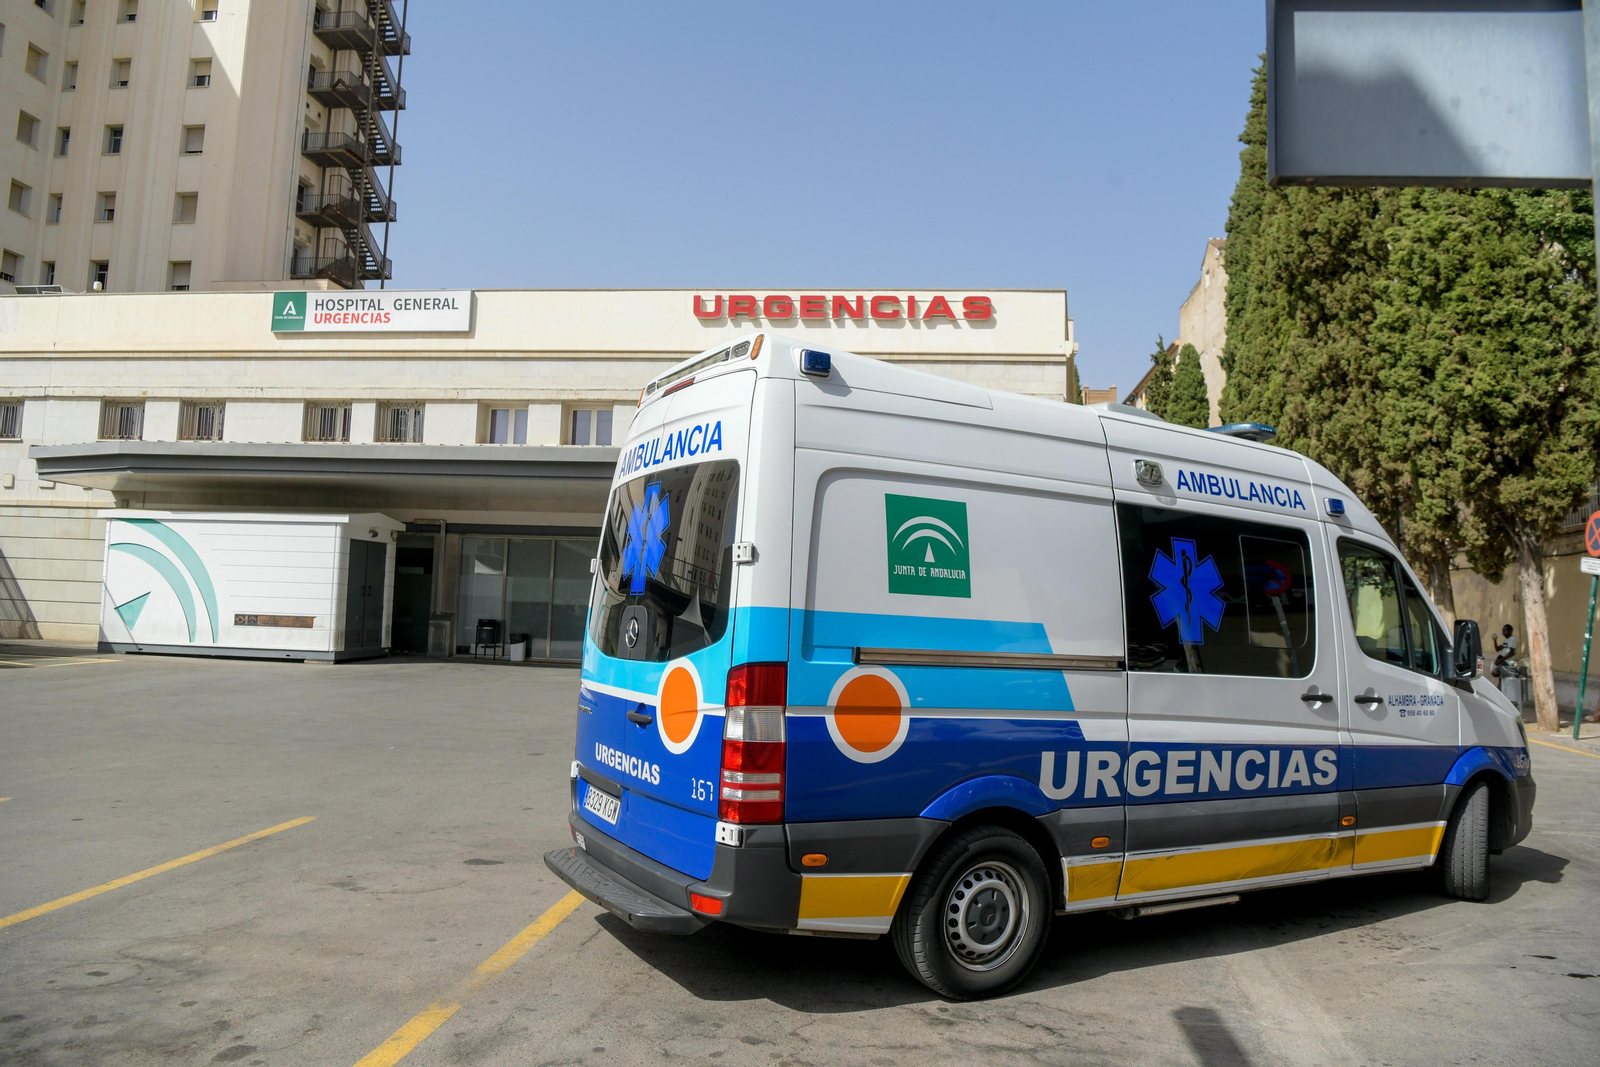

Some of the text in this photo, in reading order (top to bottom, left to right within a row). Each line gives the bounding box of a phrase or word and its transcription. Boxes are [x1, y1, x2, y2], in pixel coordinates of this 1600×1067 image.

[315, 298, 459, 311] HOSPITAL GENERAL
[693, 295, 992, 320] URGENCIAS
[314, 312, 391, 324] URGENCIAS
[618, 420, 722, 479] AMBULANCIA
[1177, 469, 1306, 511] AMBULANCIA
[893, 564, 966, 580] JUNTA DE ANDALUCIA
[1388, 695, 1417, 706] ALHAMBRA
[1420, 695, 1445, 706] GRANADA
[595, 742, 661, 786] URGENCIAS
[1039, 749, 1338, 801] URGENCIAS
[587, 788, 603, 812] 8329
[691, 777, 714, 802] 167
